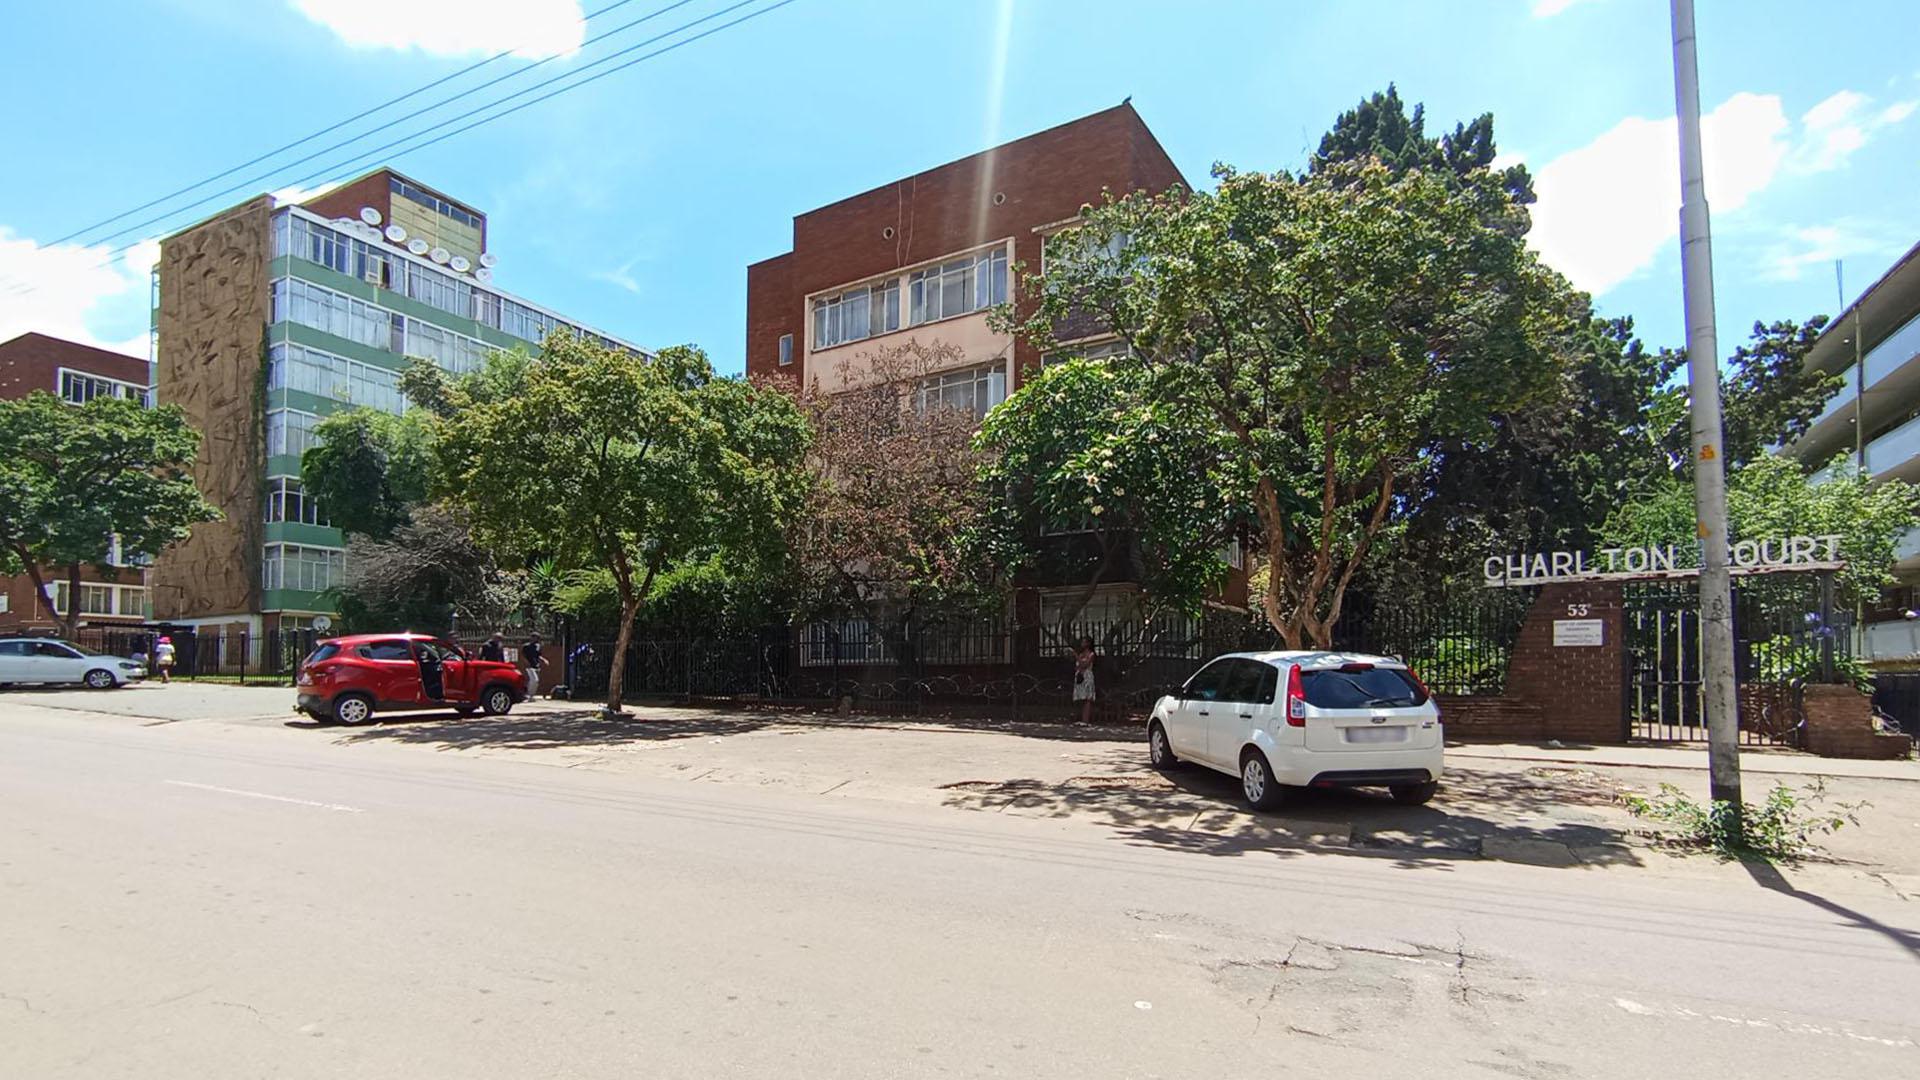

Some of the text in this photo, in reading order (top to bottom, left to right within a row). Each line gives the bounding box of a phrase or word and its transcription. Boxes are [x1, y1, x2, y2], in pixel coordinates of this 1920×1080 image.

[1483, 534, 1843, 580] CHARLTON OURT
[1567, 603, 1588, 617] 53
